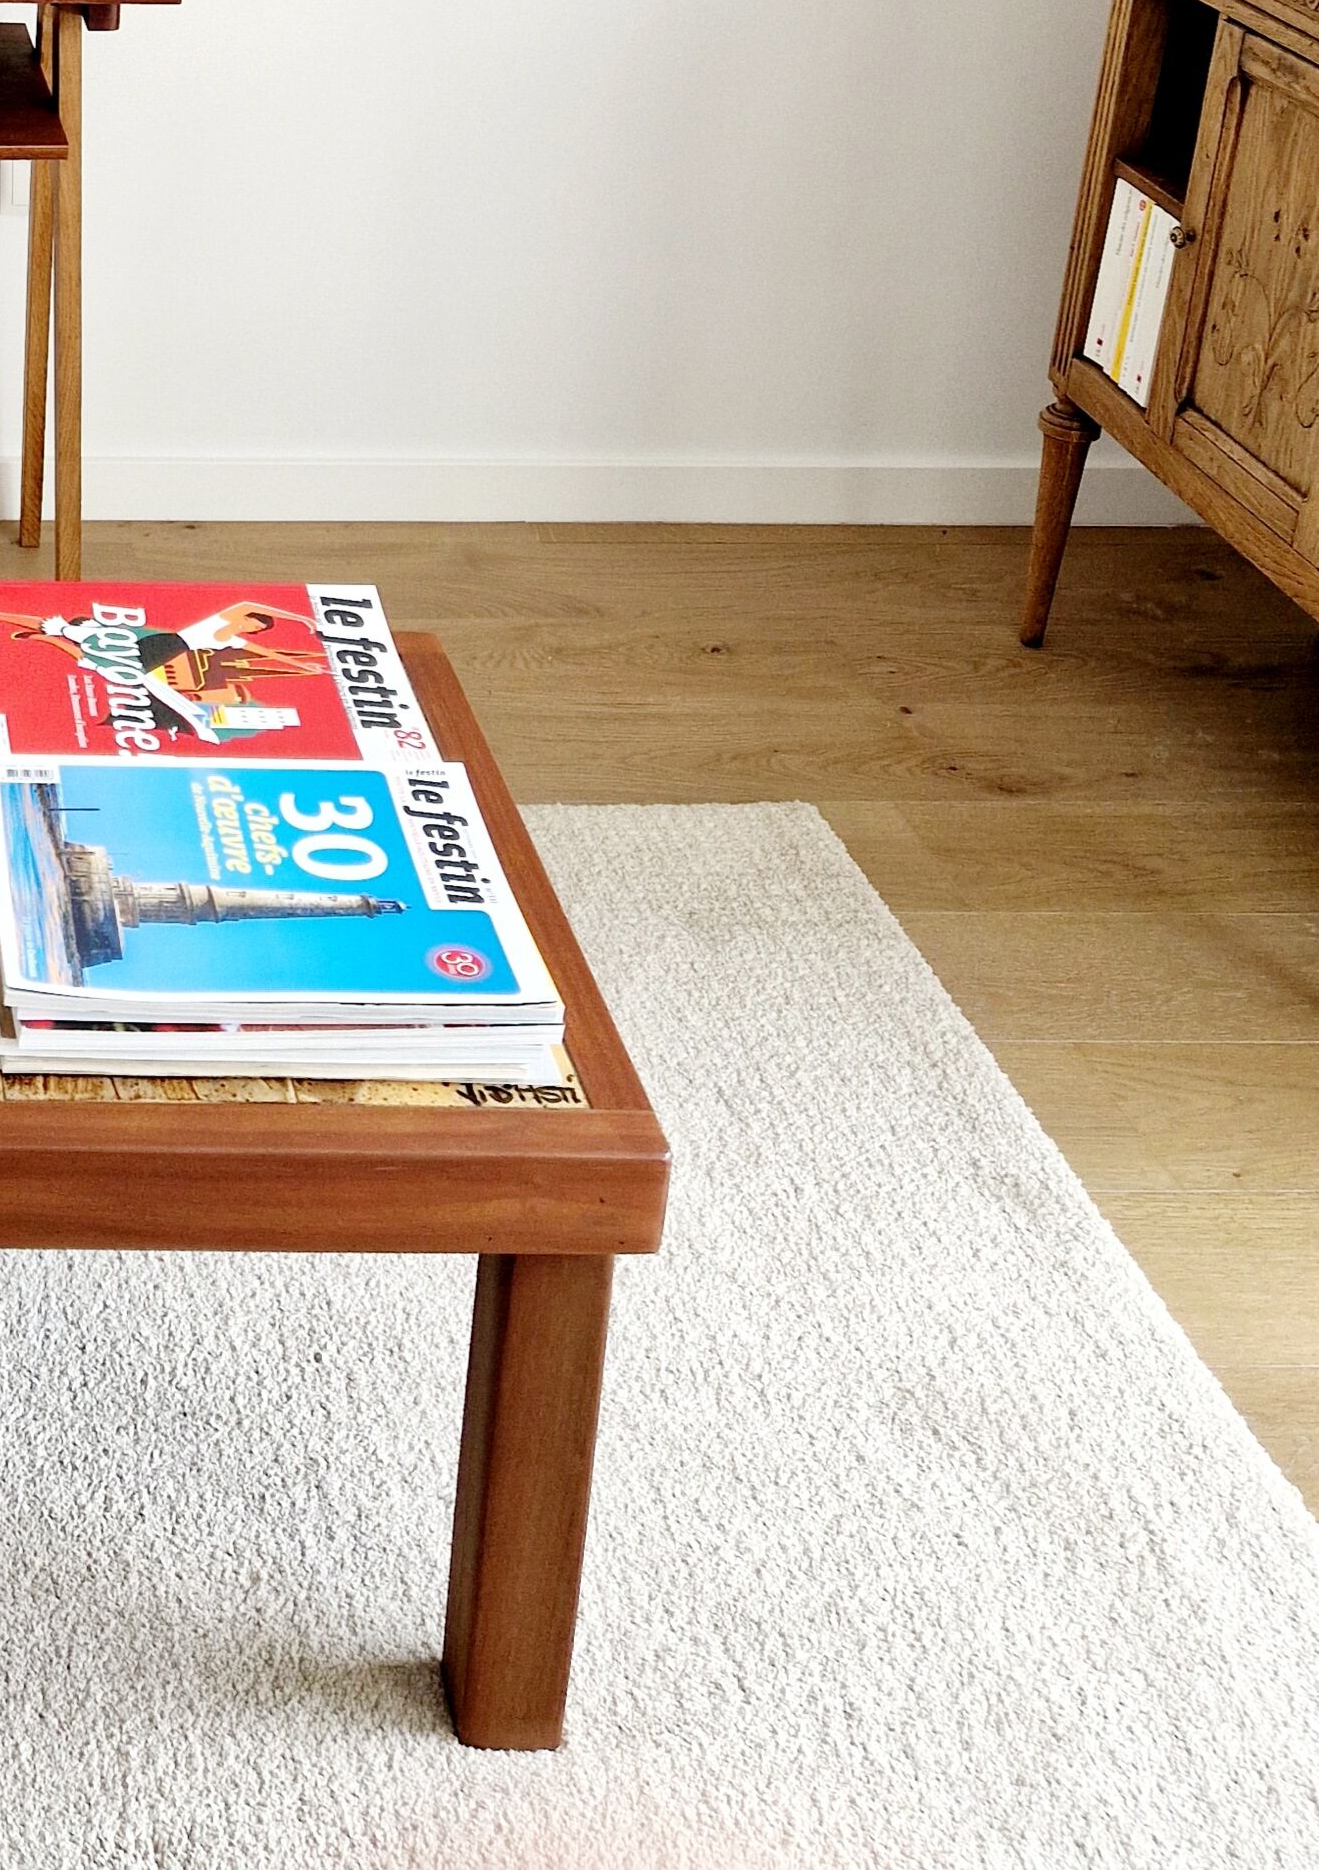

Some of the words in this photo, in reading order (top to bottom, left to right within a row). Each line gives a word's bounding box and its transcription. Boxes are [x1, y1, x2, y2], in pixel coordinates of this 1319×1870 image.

[320, 596, 373, 627] le
[316, 631, 410, 728] festin
[408, 778, 450, 804] le
[416, 769, 446, 777] festin
[207, 775, 252, 874] d'œuvre
[244, 802, 289, 875] chefs-
[279, 792, 389, 880] 30
[403, 805, 491, 903] festin
[441, 952, 479, 976] 30
